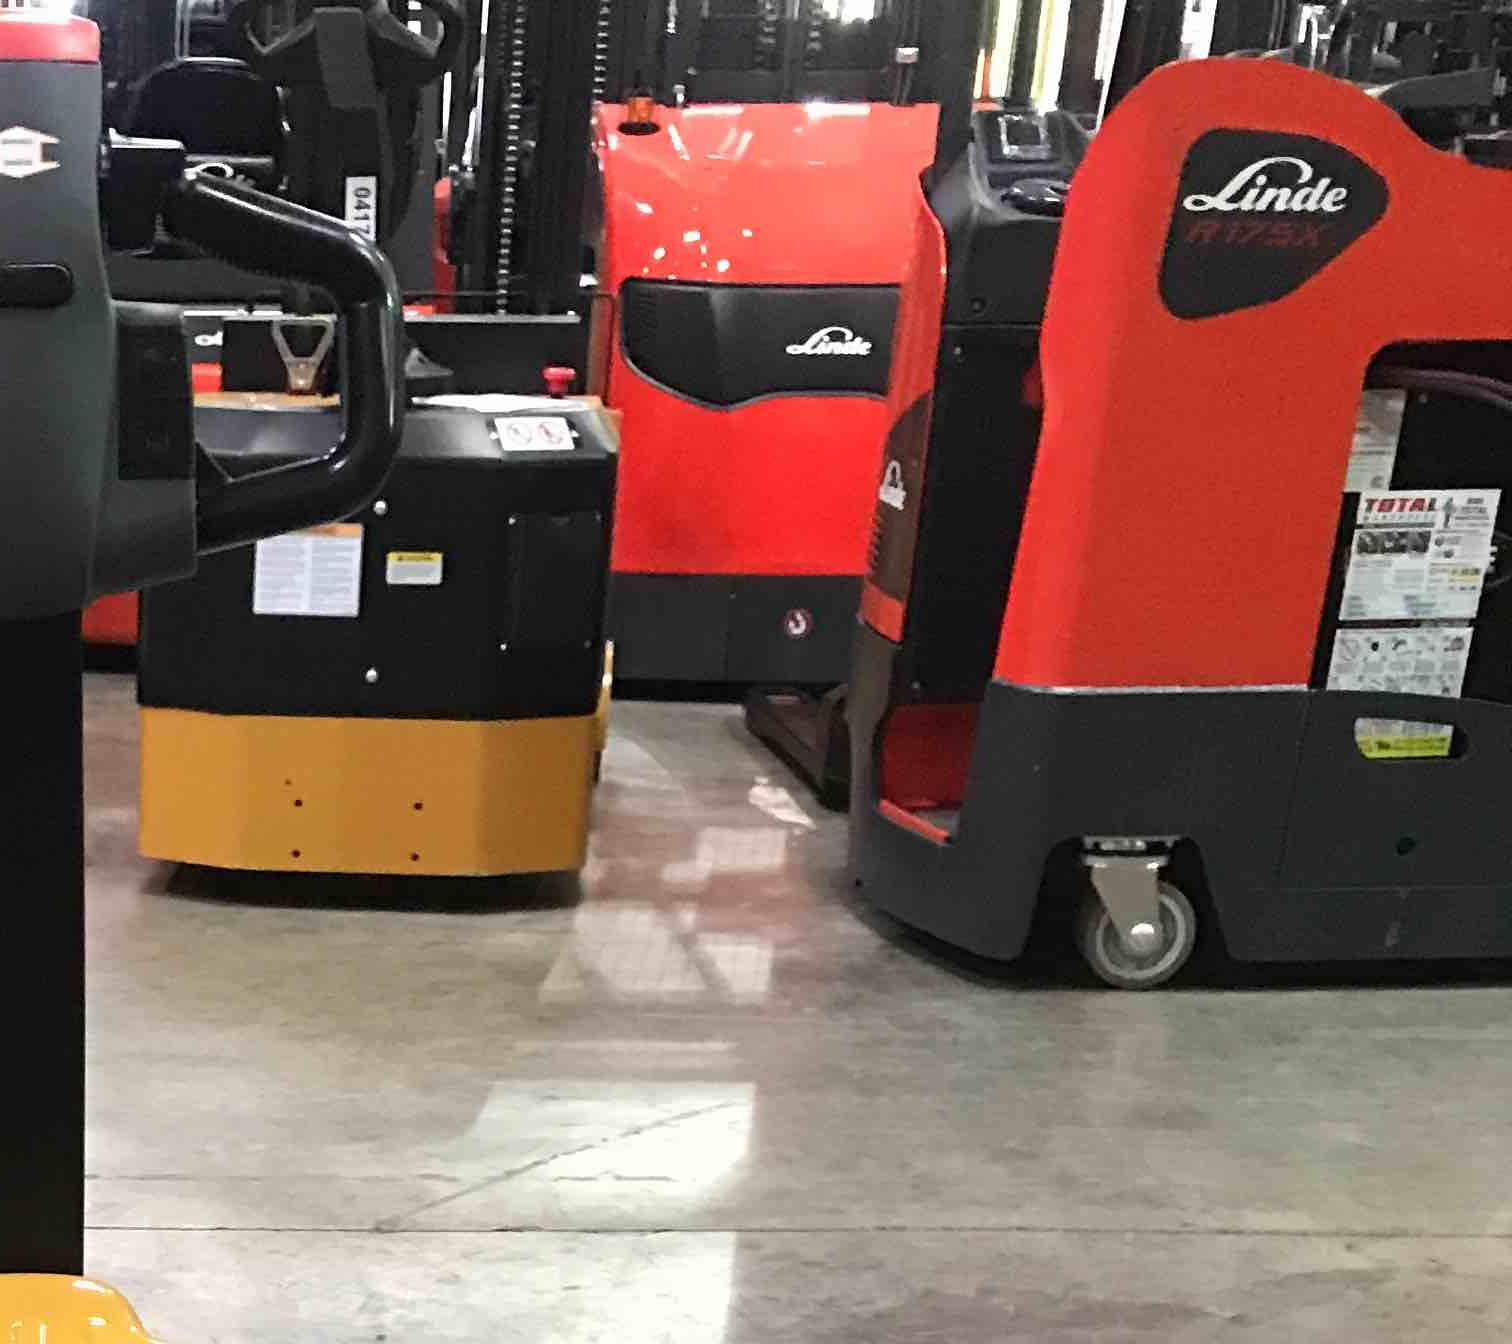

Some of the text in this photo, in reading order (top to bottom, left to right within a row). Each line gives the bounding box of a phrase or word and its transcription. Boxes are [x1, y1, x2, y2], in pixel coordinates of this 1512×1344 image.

[1183, 156, 1347, 212] Linde
[786, 326, 872, 355] Linde
[1364, 497, 1438, 513] TOTAL
